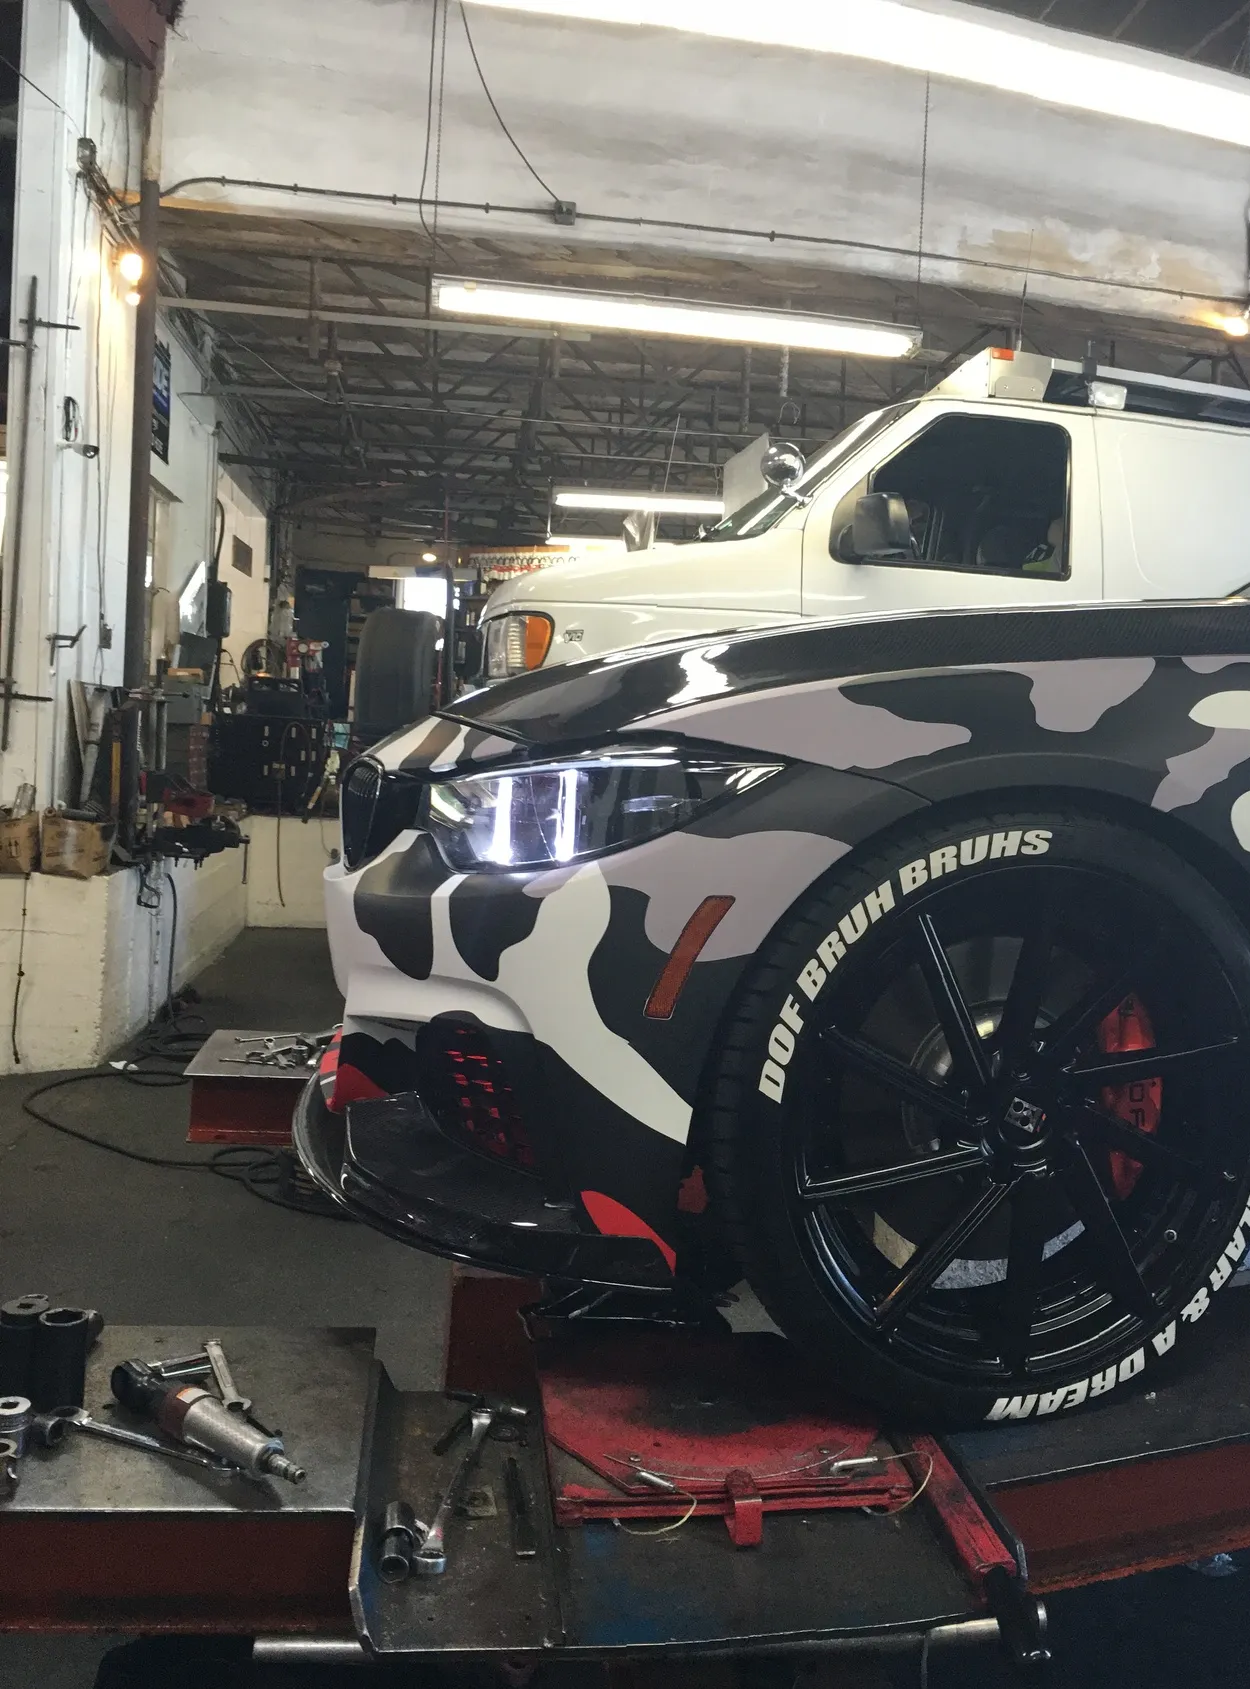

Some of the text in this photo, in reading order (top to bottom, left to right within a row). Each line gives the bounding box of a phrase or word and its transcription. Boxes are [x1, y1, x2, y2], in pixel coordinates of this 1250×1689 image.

[758, 829, 1053, 1104] DOF BRUH BRUHS
[1179, 1286, 1210, 1323] &
[1151, 1319, 1176, 1357] A
[983, 1346, 1145, 1420] DREAM
